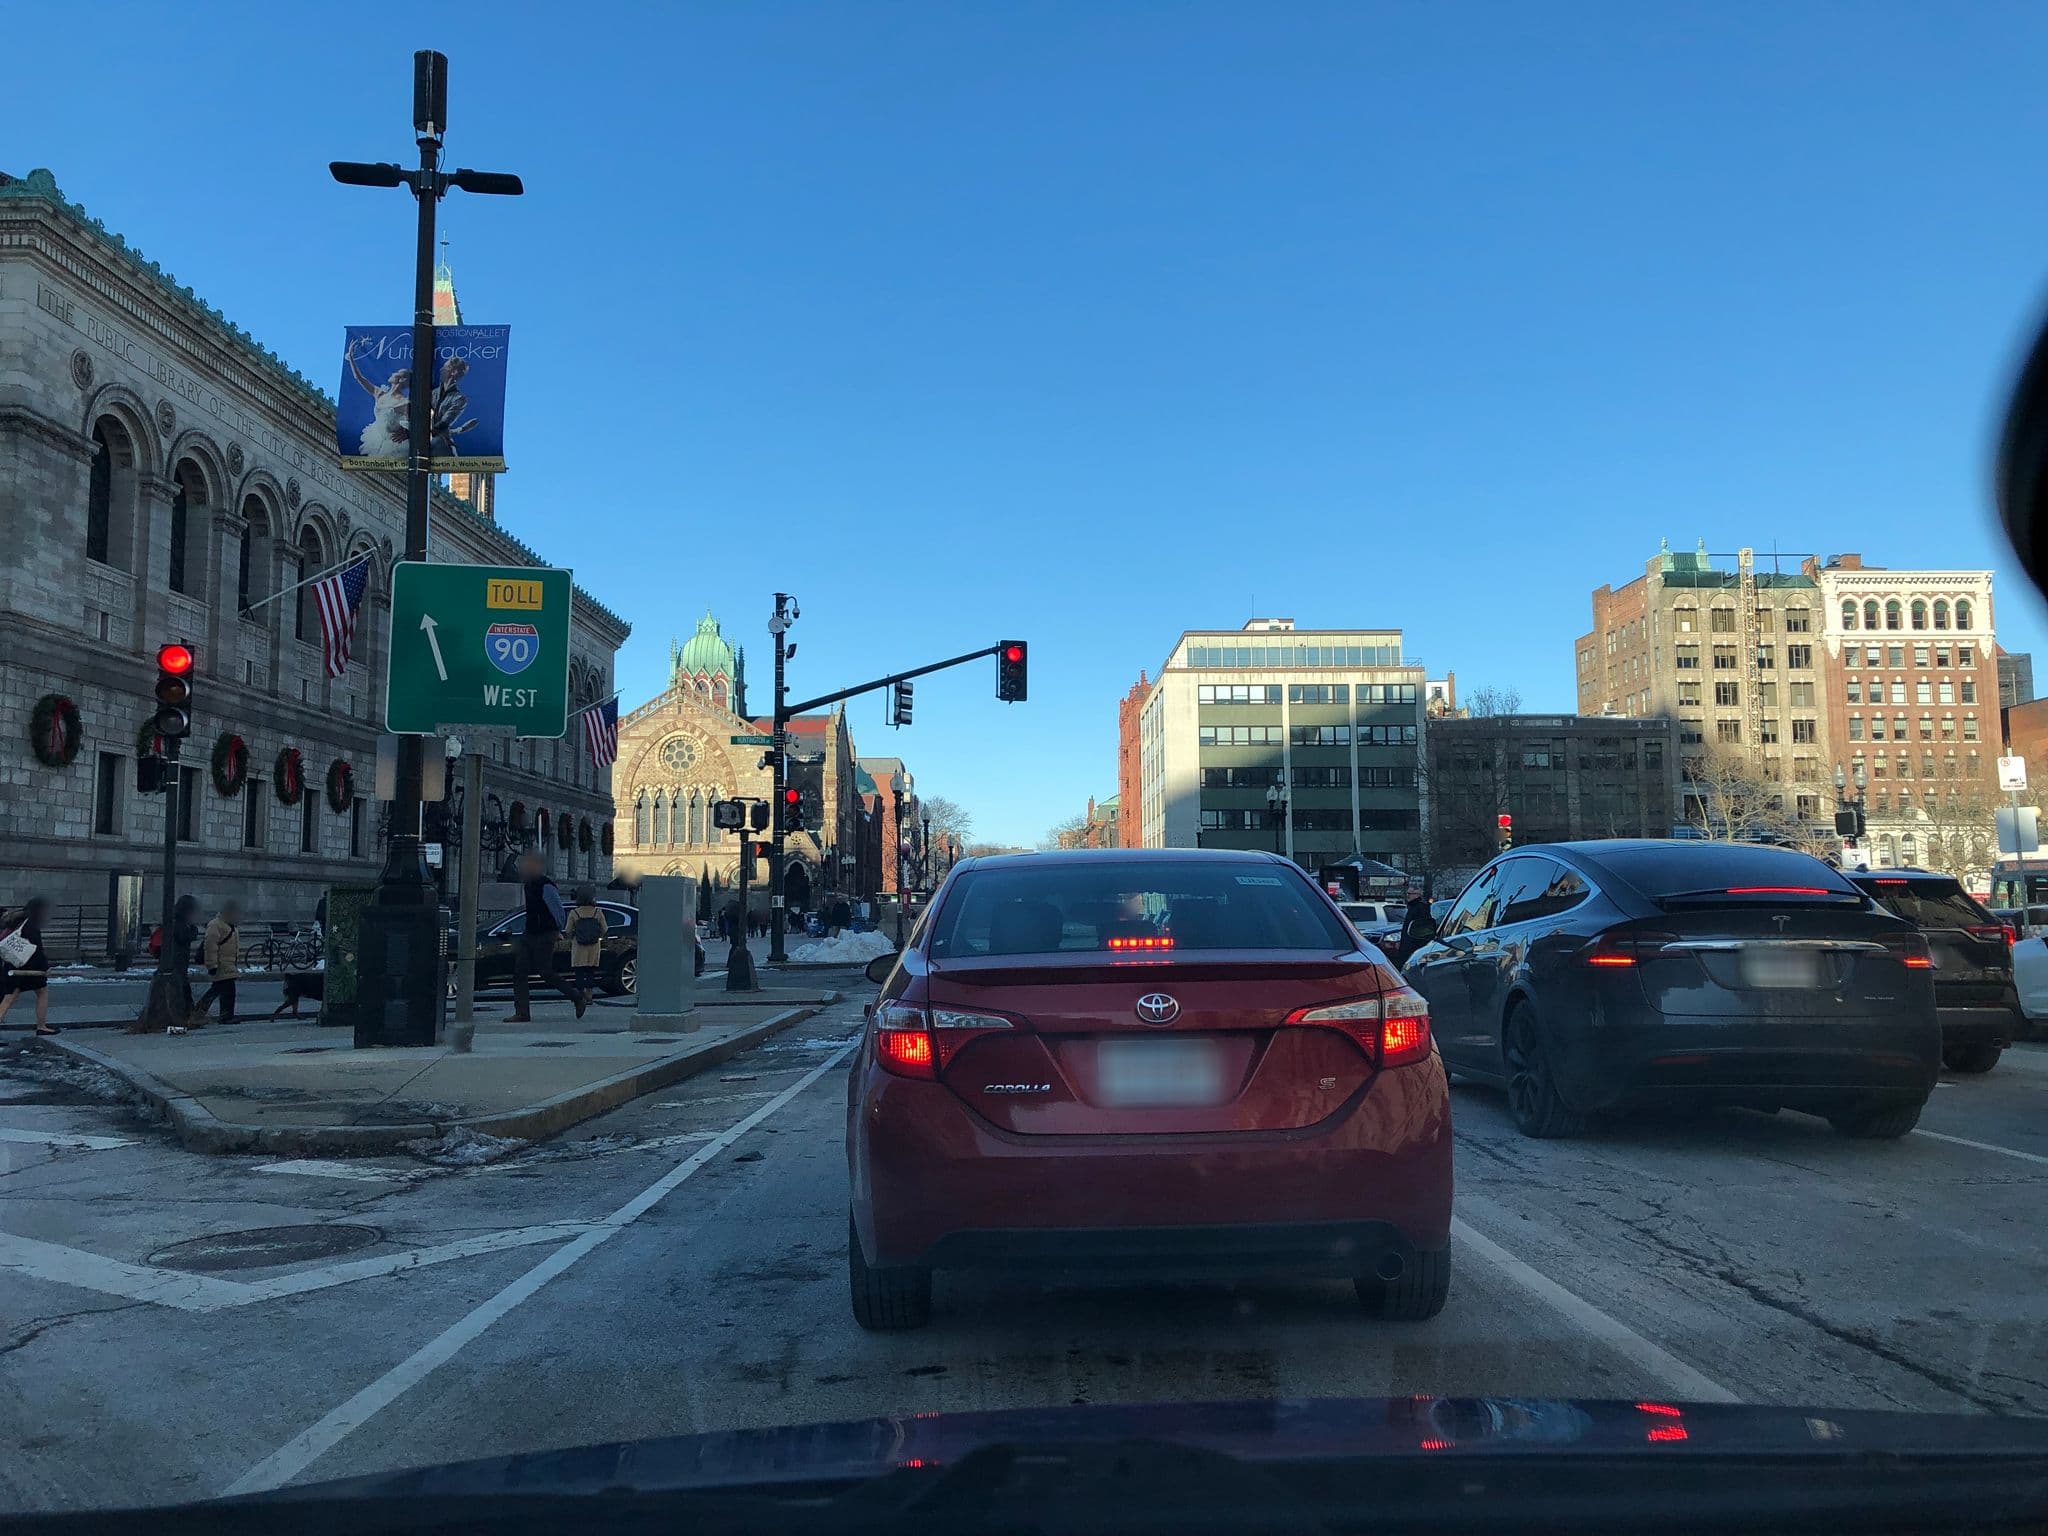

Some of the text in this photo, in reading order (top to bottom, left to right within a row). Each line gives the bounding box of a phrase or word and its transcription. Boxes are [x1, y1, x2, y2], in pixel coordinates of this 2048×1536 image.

[44, 289, 75, 327] THE
[87, 317, 135, 362] PUBLIC
[147, 356, 201, 405] LIBRARY
[209, 397, 226, 421] OF
[234, 411, 255, 438] THE
[262, 431, 288, 457] CITY
[293, 451, 306, 470] OF
[311, 463, 347, 498] BOSTON
[492, 584, 538, 603] TOLL
[494, 626, 531, 634] INTERSTATE
[494, 638, 529, 662] 90
[483, 684, 537, 707] WEST
[983, 1084, 1051, 1094] COROLLA
